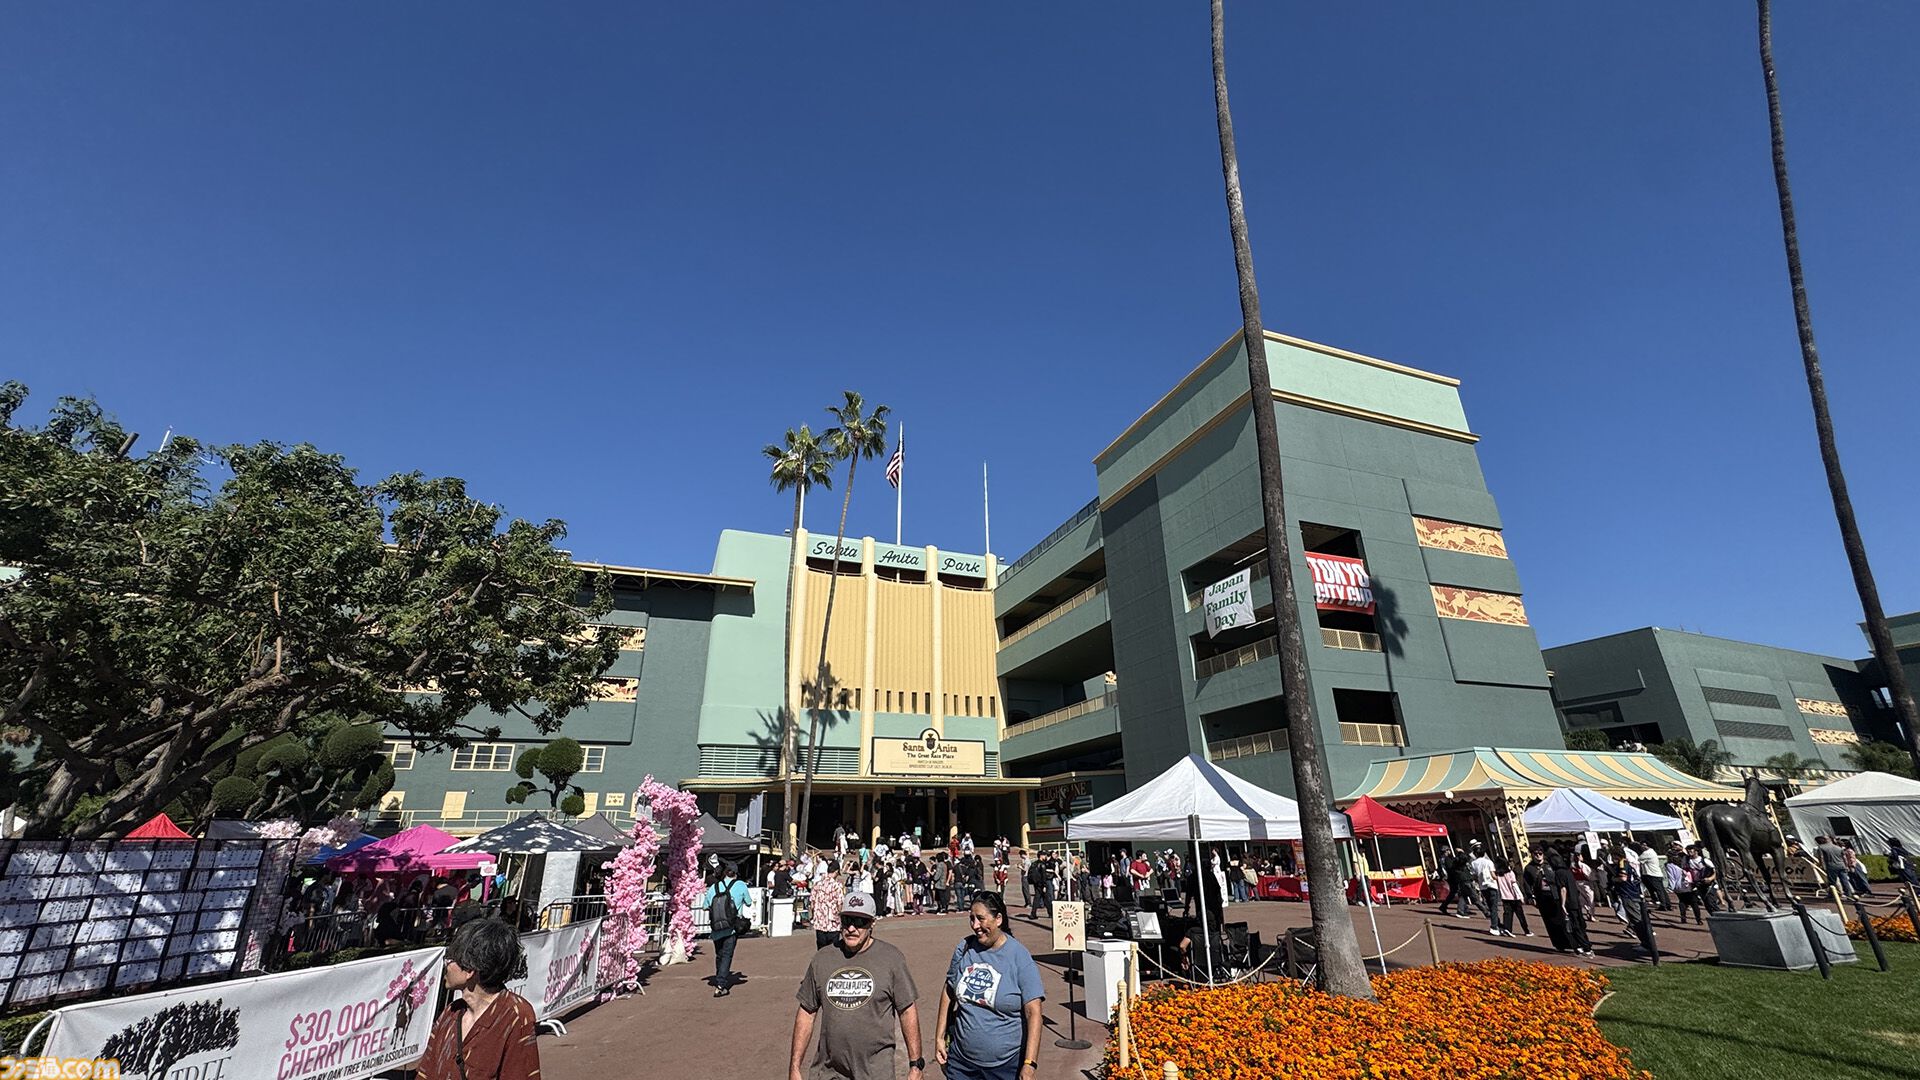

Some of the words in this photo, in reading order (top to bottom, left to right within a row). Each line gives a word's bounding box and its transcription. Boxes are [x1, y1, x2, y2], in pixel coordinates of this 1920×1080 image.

[813, 541, 858, 558] Santa
[879, 550, 920, 566] Anita
[941, 557, 981, 573] Park
[1208, 573, 1244, 597] Japan
[1306, 556, 1370, 588] TOKYO
[1206, 589, 1248, 616] Family
[1315, 582, 1346, 604] CITY
[1346, 585, 1373, 609] CUP
[1214, 611, 1238, 630] Day
[902, 742, 926, 752] Santa
[933, 743, 958, 753] Anita
[285, 999, 379, 1052] $30,000
[277, 1037, 350, 1080] CHERRY
[351, 1027, 389, 1060] TREE
[343, 1064, 360, 1077] TREE
[361, 1055, 384, 1070] RACING
[384, 1043, 419, 1063] ASSOCIATION
[171, 1056, 231, 1080] EE
